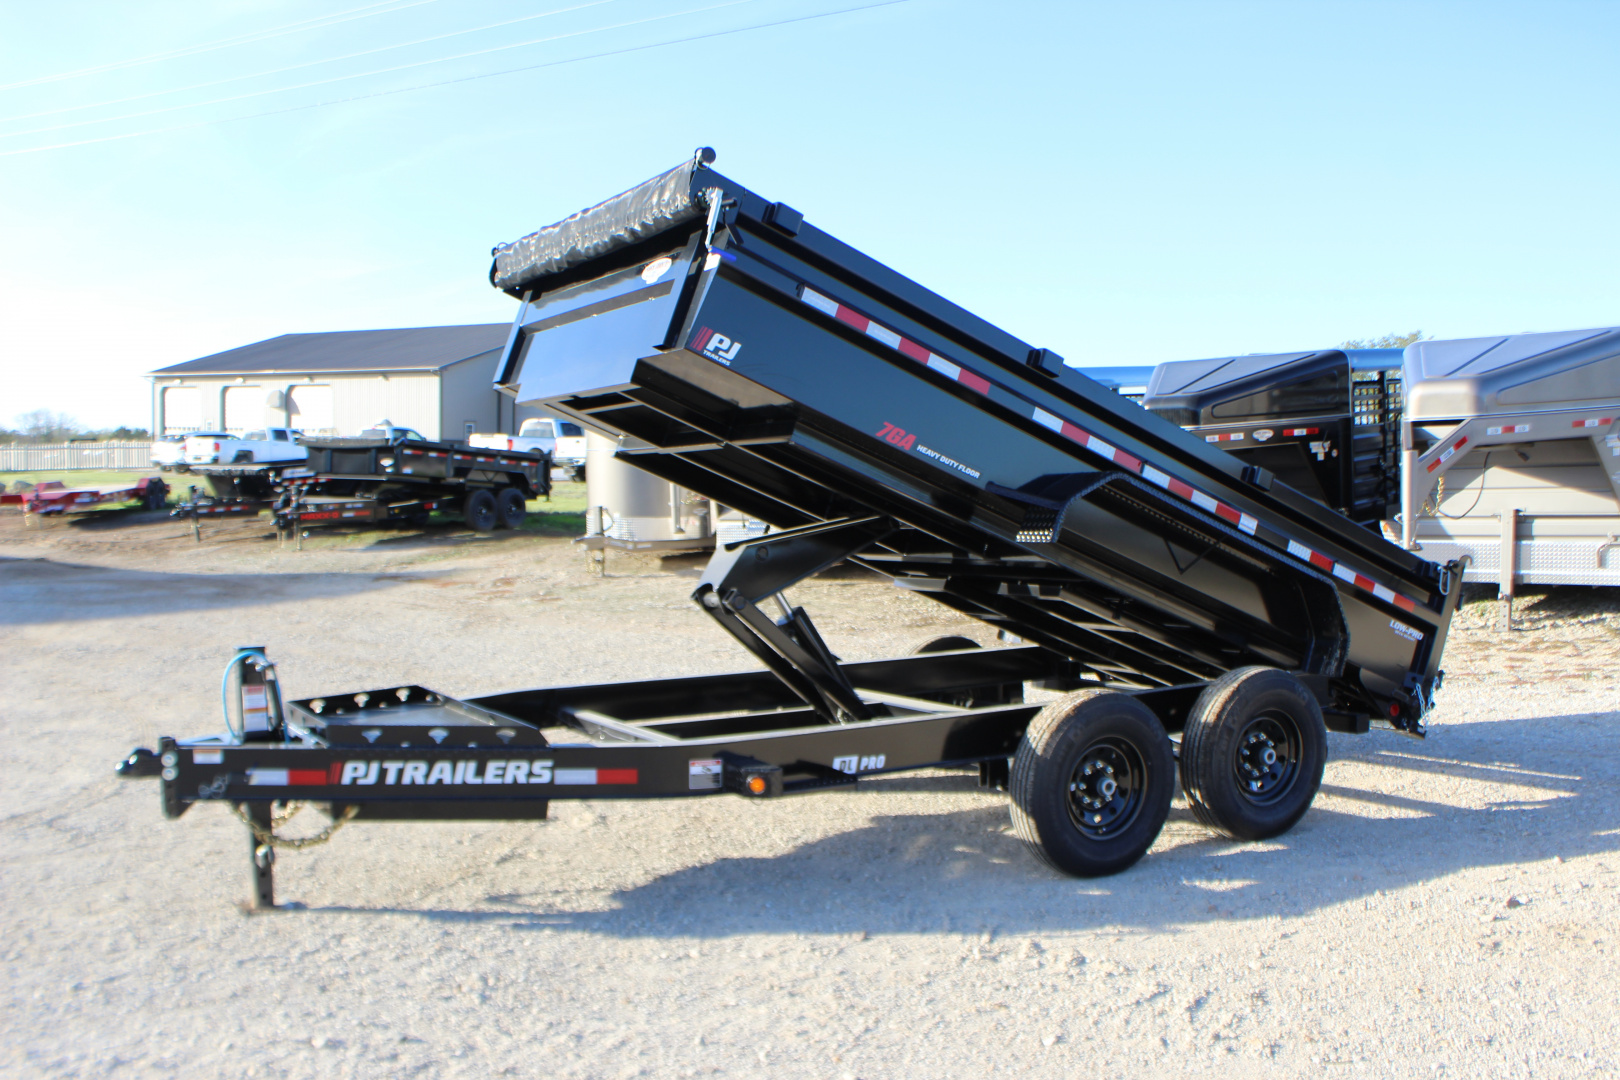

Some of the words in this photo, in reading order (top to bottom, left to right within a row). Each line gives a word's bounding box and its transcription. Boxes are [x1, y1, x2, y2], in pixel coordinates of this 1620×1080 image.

[702, 349, 731, 366] TRAILERS
[706, 332, 742, 361] PJ
[875, 421, 917, 451] 7GA
[916, 444, 941, 459] HEAVY
[939, 454, 960, 469] DUTY
[957, 463, 981, 479] FLOOR
[1389, 620, 1424, 640] LOW-PRO
[341, 760, 380, 785] PJ
[382, 760, 554, 785] TRAILERS
[859, 754, 886, 770] PRO
